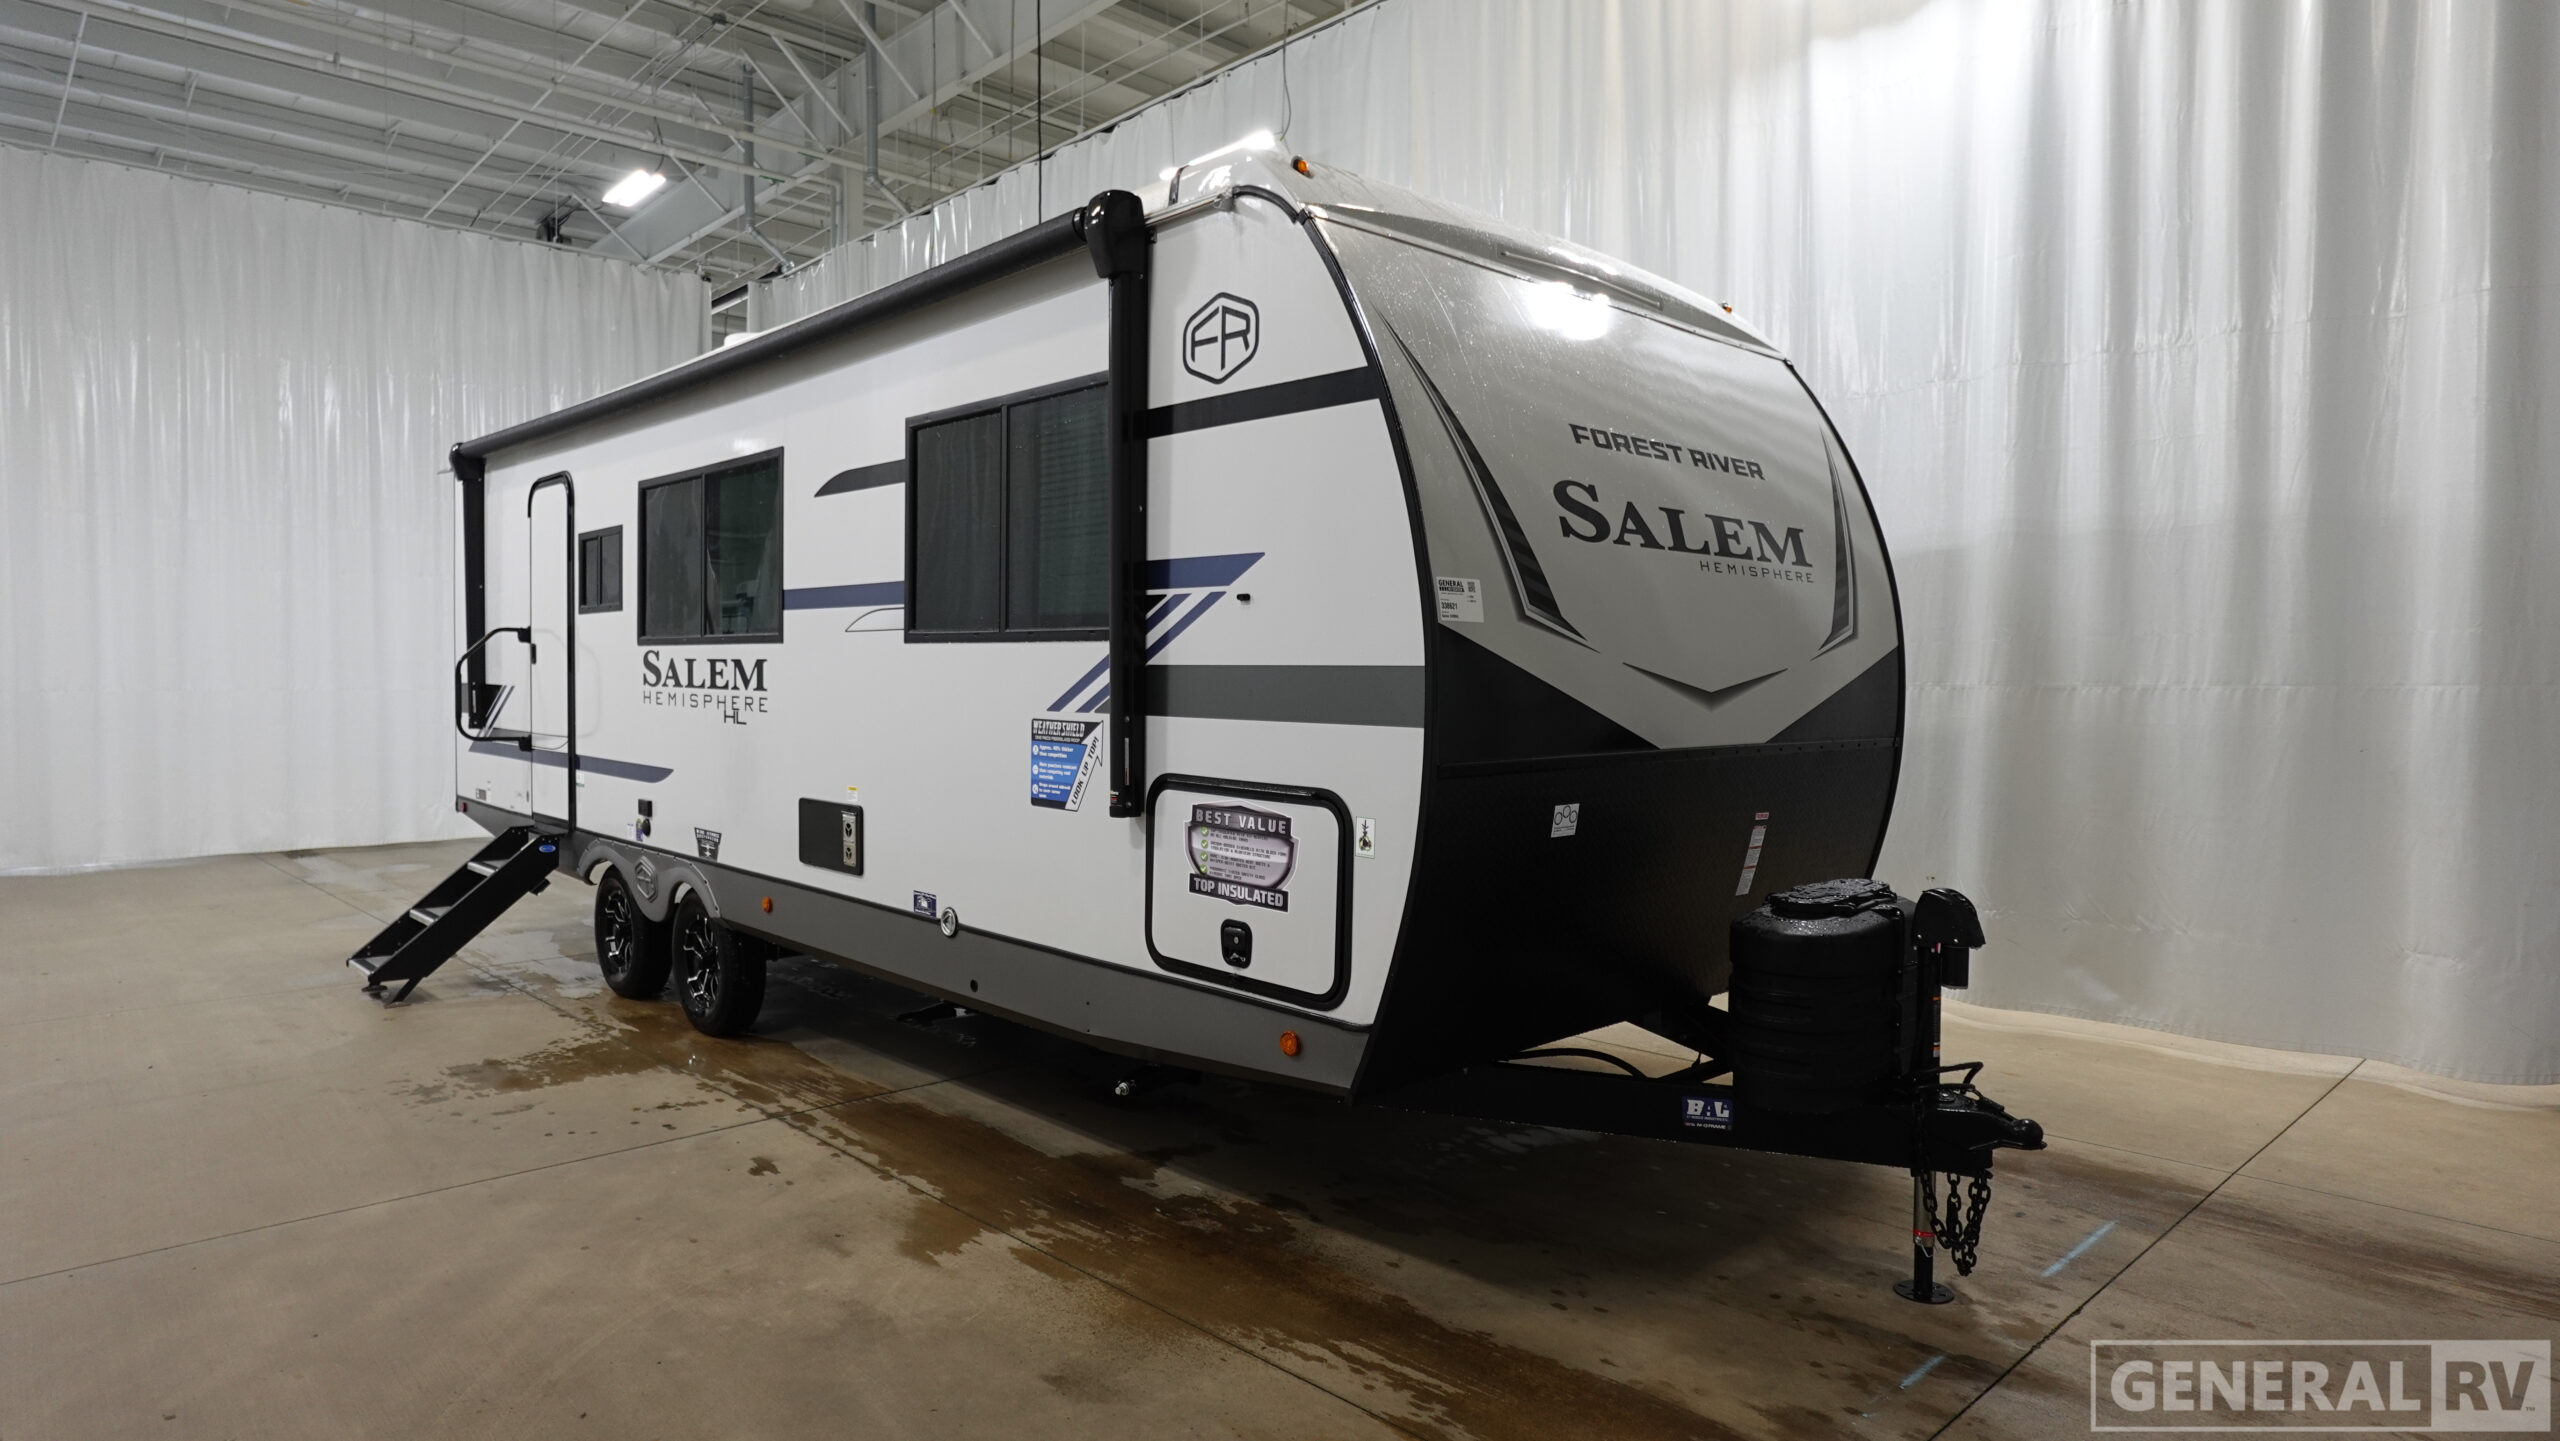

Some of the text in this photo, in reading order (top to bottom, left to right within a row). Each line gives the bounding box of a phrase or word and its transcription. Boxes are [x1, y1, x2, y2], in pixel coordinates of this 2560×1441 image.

[1190, 305, 1251, 371] FR
[1567, 423, 1766, 481] FOREST RIVER
[1553, 479, 1813, 567] SALEM
[1438, 580, 1464, 588] GENERAL
[1699, 560, 1814, 583] HEMISPHERE
[643, 649, 768, 691] SALEM
[643, 691, 768, 713] HEMISPHERE
[724, 709, 747, 725] HL
[1071, 736, 1099, 805] LOOK UP TOP!
[1195, 809, 1231, 826] BEST
[1239, 815, 1287, 835] VALUE
[1193, 877, 1284, 907] TOP INSULATED
